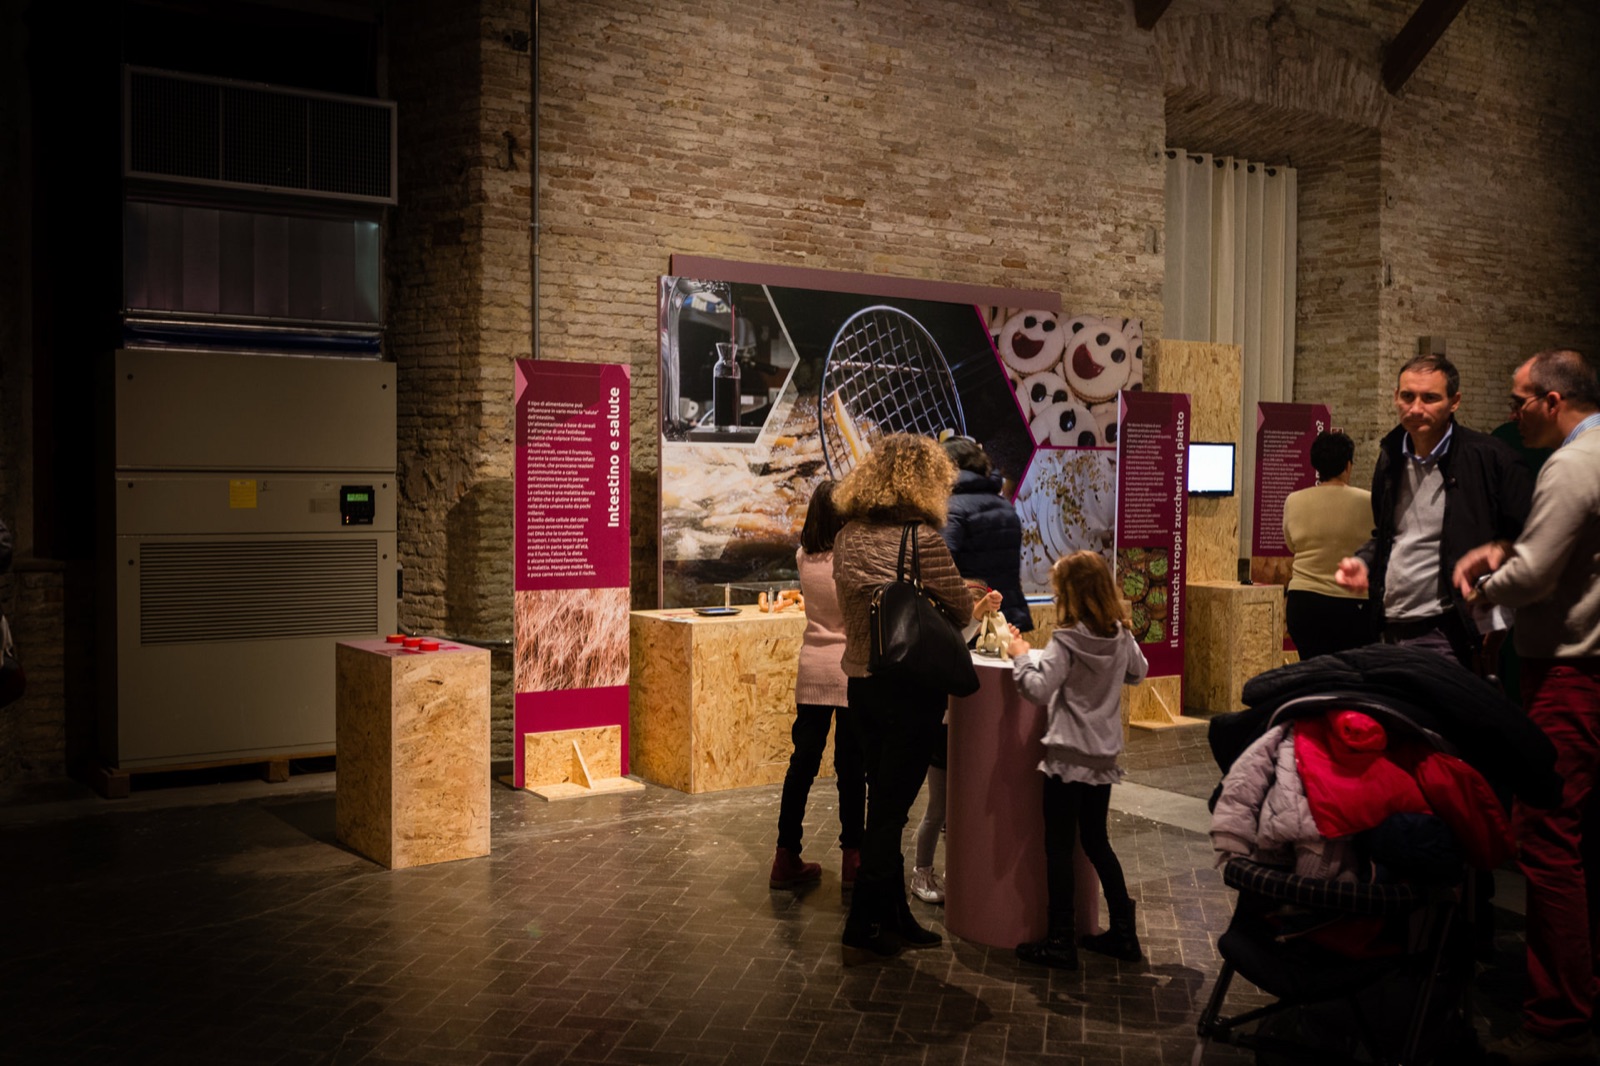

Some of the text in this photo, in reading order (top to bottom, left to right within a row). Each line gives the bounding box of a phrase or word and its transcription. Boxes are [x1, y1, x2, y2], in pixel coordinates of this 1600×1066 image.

[607, 387, 620, 528] Intestino e salute
[1170, 411, 1185, 648] Il mismatch: troppi zuccheri nel piatto
